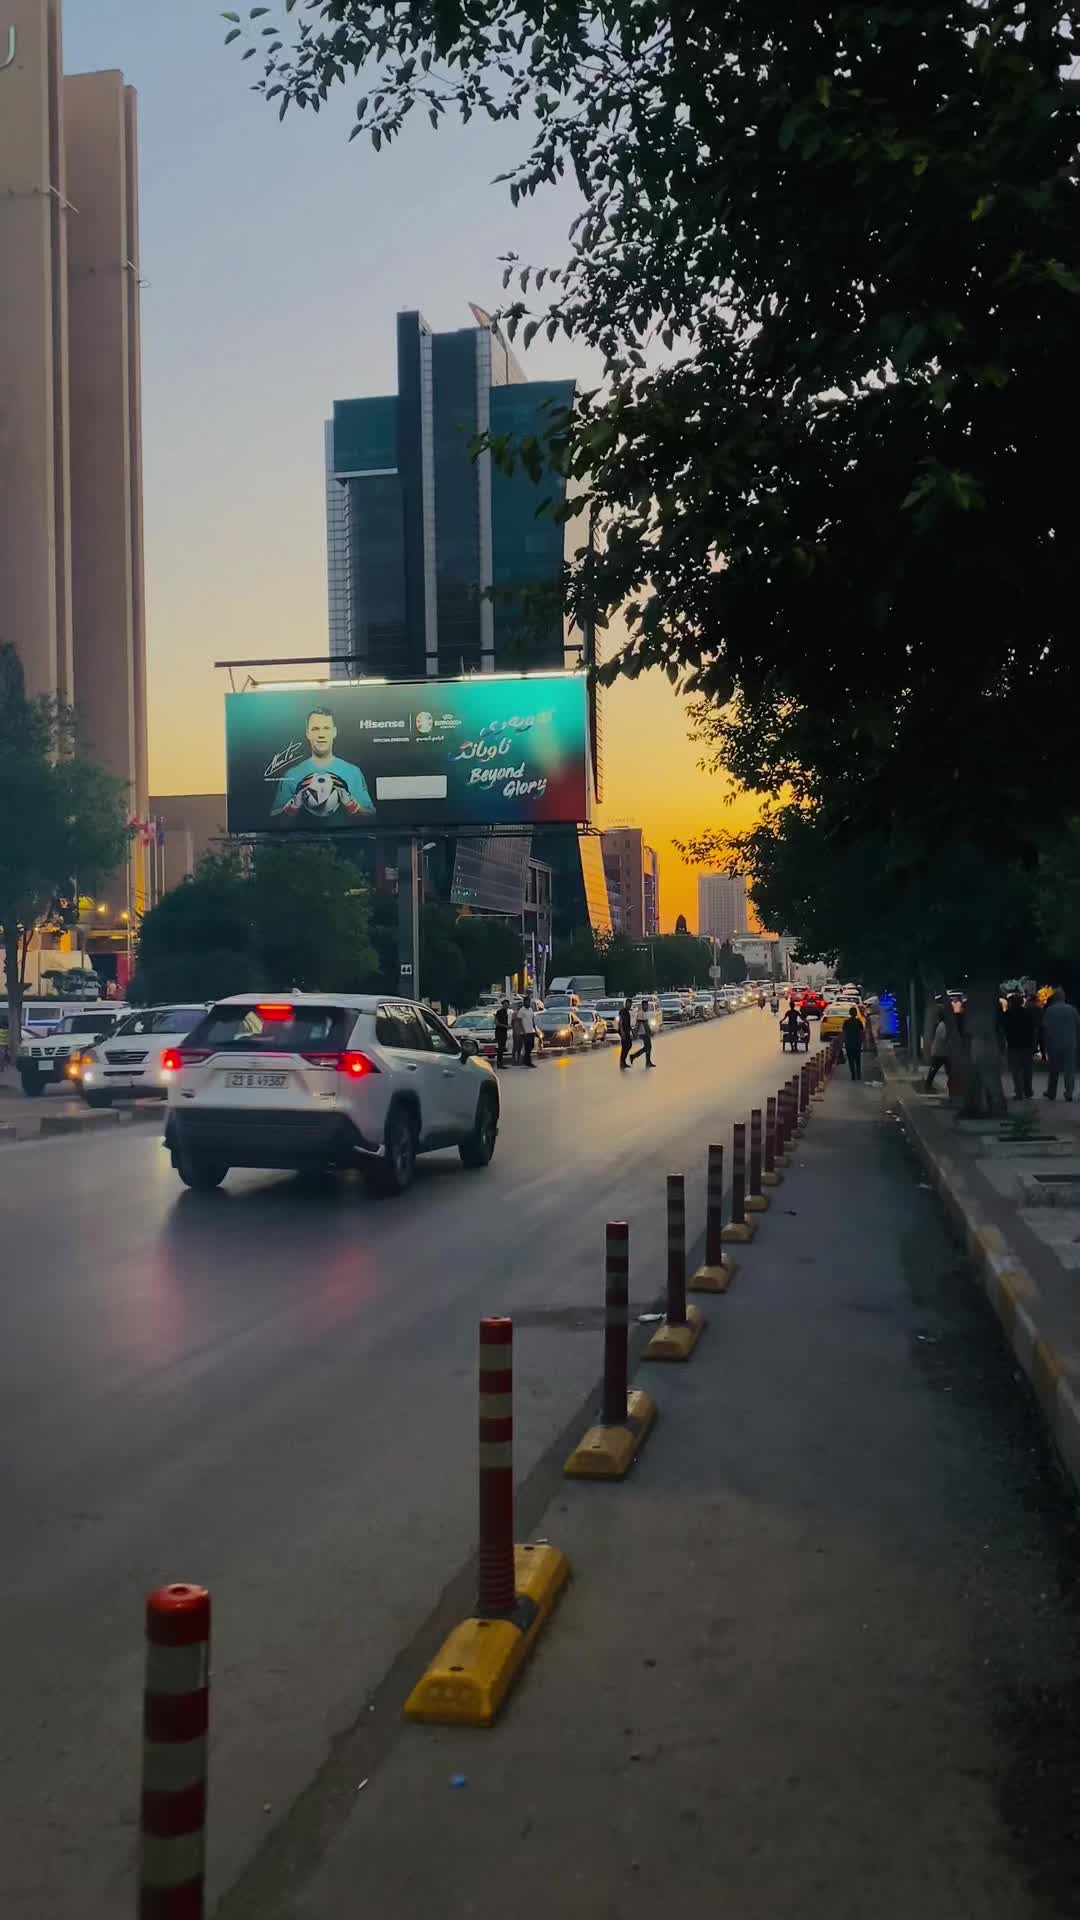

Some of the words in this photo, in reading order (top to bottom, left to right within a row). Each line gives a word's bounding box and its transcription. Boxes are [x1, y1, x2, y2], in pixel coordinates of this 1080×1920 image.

[359, 719, 405, 729] Hisense
[467, 761, 525, 788] Beyond
[503, 779, 547, 799] Glory
